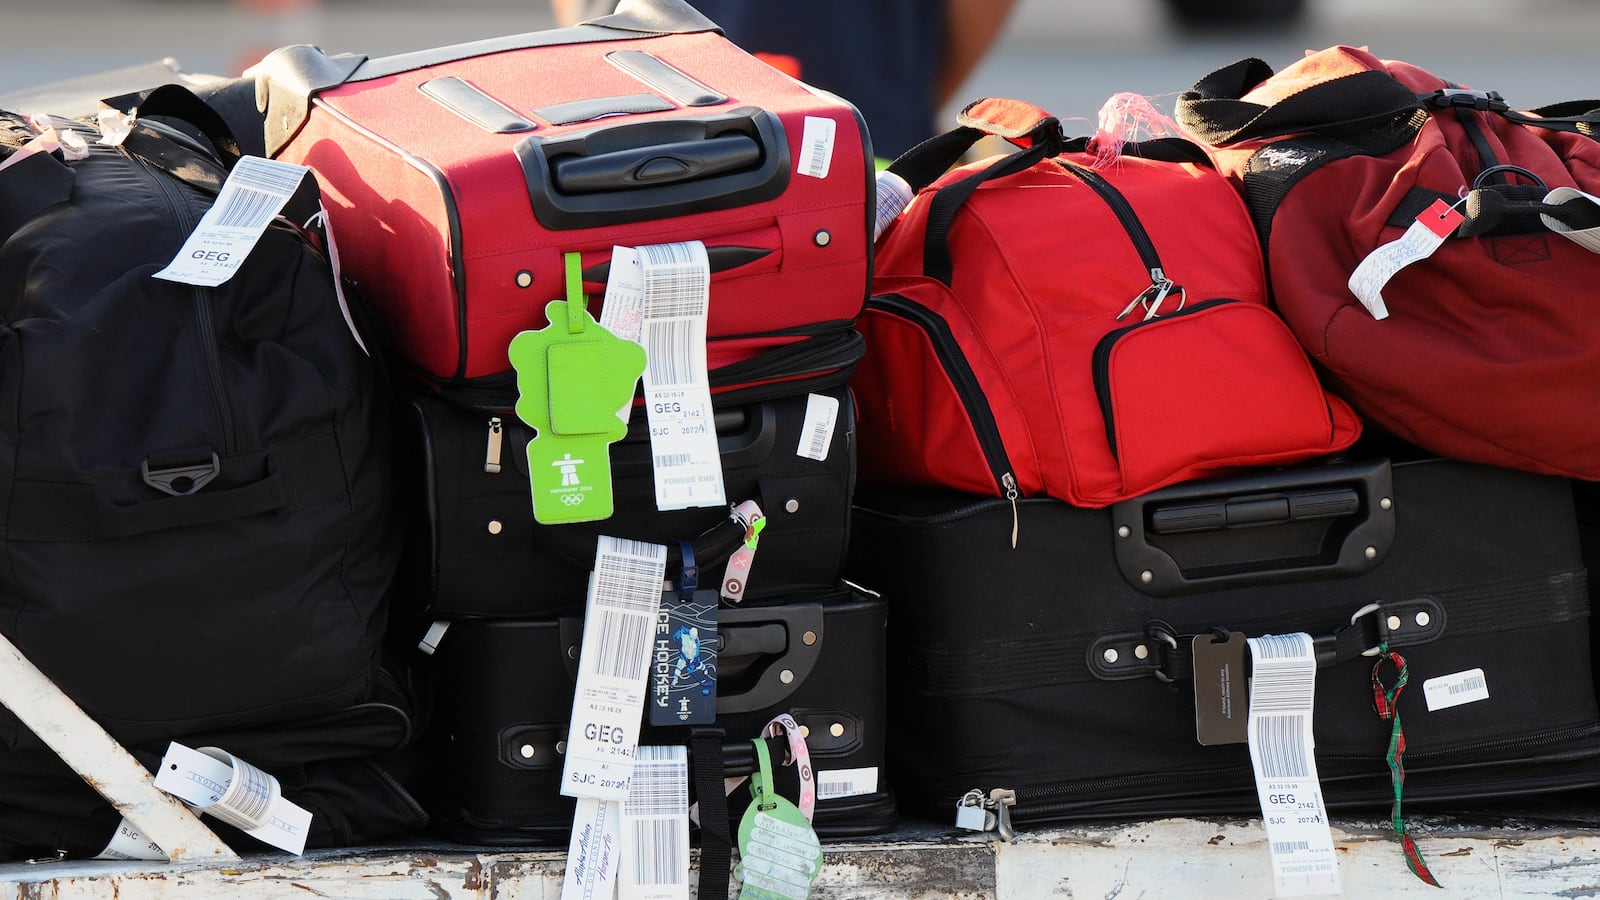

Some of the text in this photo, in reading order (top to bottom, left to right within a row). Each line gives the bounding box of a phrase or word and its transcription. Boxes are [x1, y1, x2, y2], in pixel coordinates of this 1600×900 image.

[191, 250, 230, 262] GEG
[654, 402, 681, 414] GEG
[652, 427, 669, 436] SJC
[656, 608, 670, 708] ICE HOCKEY
[584, 722, 624, 745] GEG
[610, 746, 633, 757] 2142
[571, 771, 596, 785] SJC
[1269, 793, 1296, 805] GEG
[1269, 816, 1286, 825] SJC
[120, 826, 139, 841] SJC
